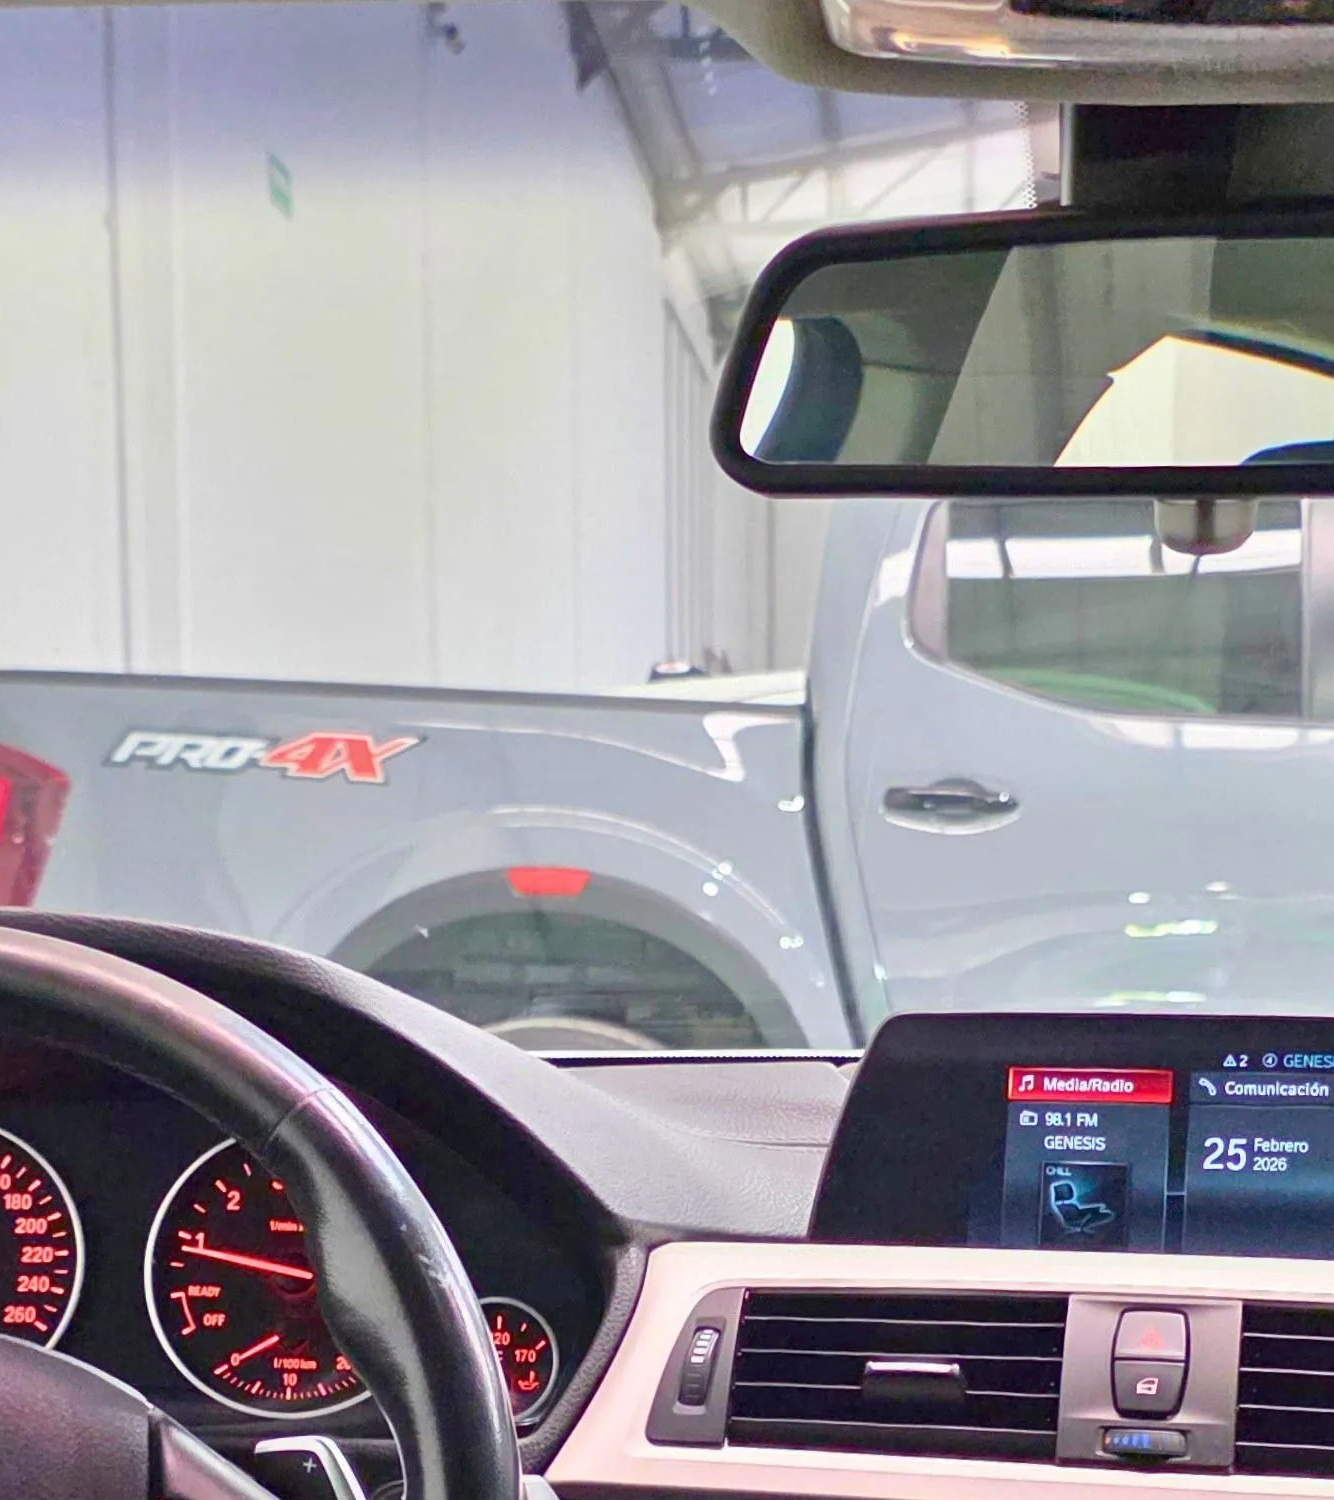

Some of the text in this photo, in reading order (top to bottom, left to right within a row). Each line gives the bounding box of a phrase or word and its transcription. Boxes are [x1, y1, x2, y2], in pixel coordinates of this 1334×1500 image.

[1239, 1054, 1249, 1068] 2
[1043, 1076, 1135, 1094] Media/Radio
[1224, 1081, 1330, 1097] Comunicación
[1044, 1112, 1098, 1128] 98.1 FM
[1043, 1136, 1107, 1151] GENESIS
[1202, 1137, 1309, 1172] 25 Febrero
[1253, 1157, 1288, 1172] 2026
[3, 1194, 33, 1210] 180
[226, 1191, 241, 1211] 2
[15, 1218, 48, 1234] 200
[21, 1246, 54, 1264] 220
[17, 1276, 50, 1293] 240
[188, 1285, 221, 1297] READY
[3, 1306, 37, 1324] 260
[203, 1313, 226, 1327] OFF
[491, 1331, 511, 1346] 20
[515, 1348, 537, 1363] 170
[283, 1373, 298, 1386] 10
